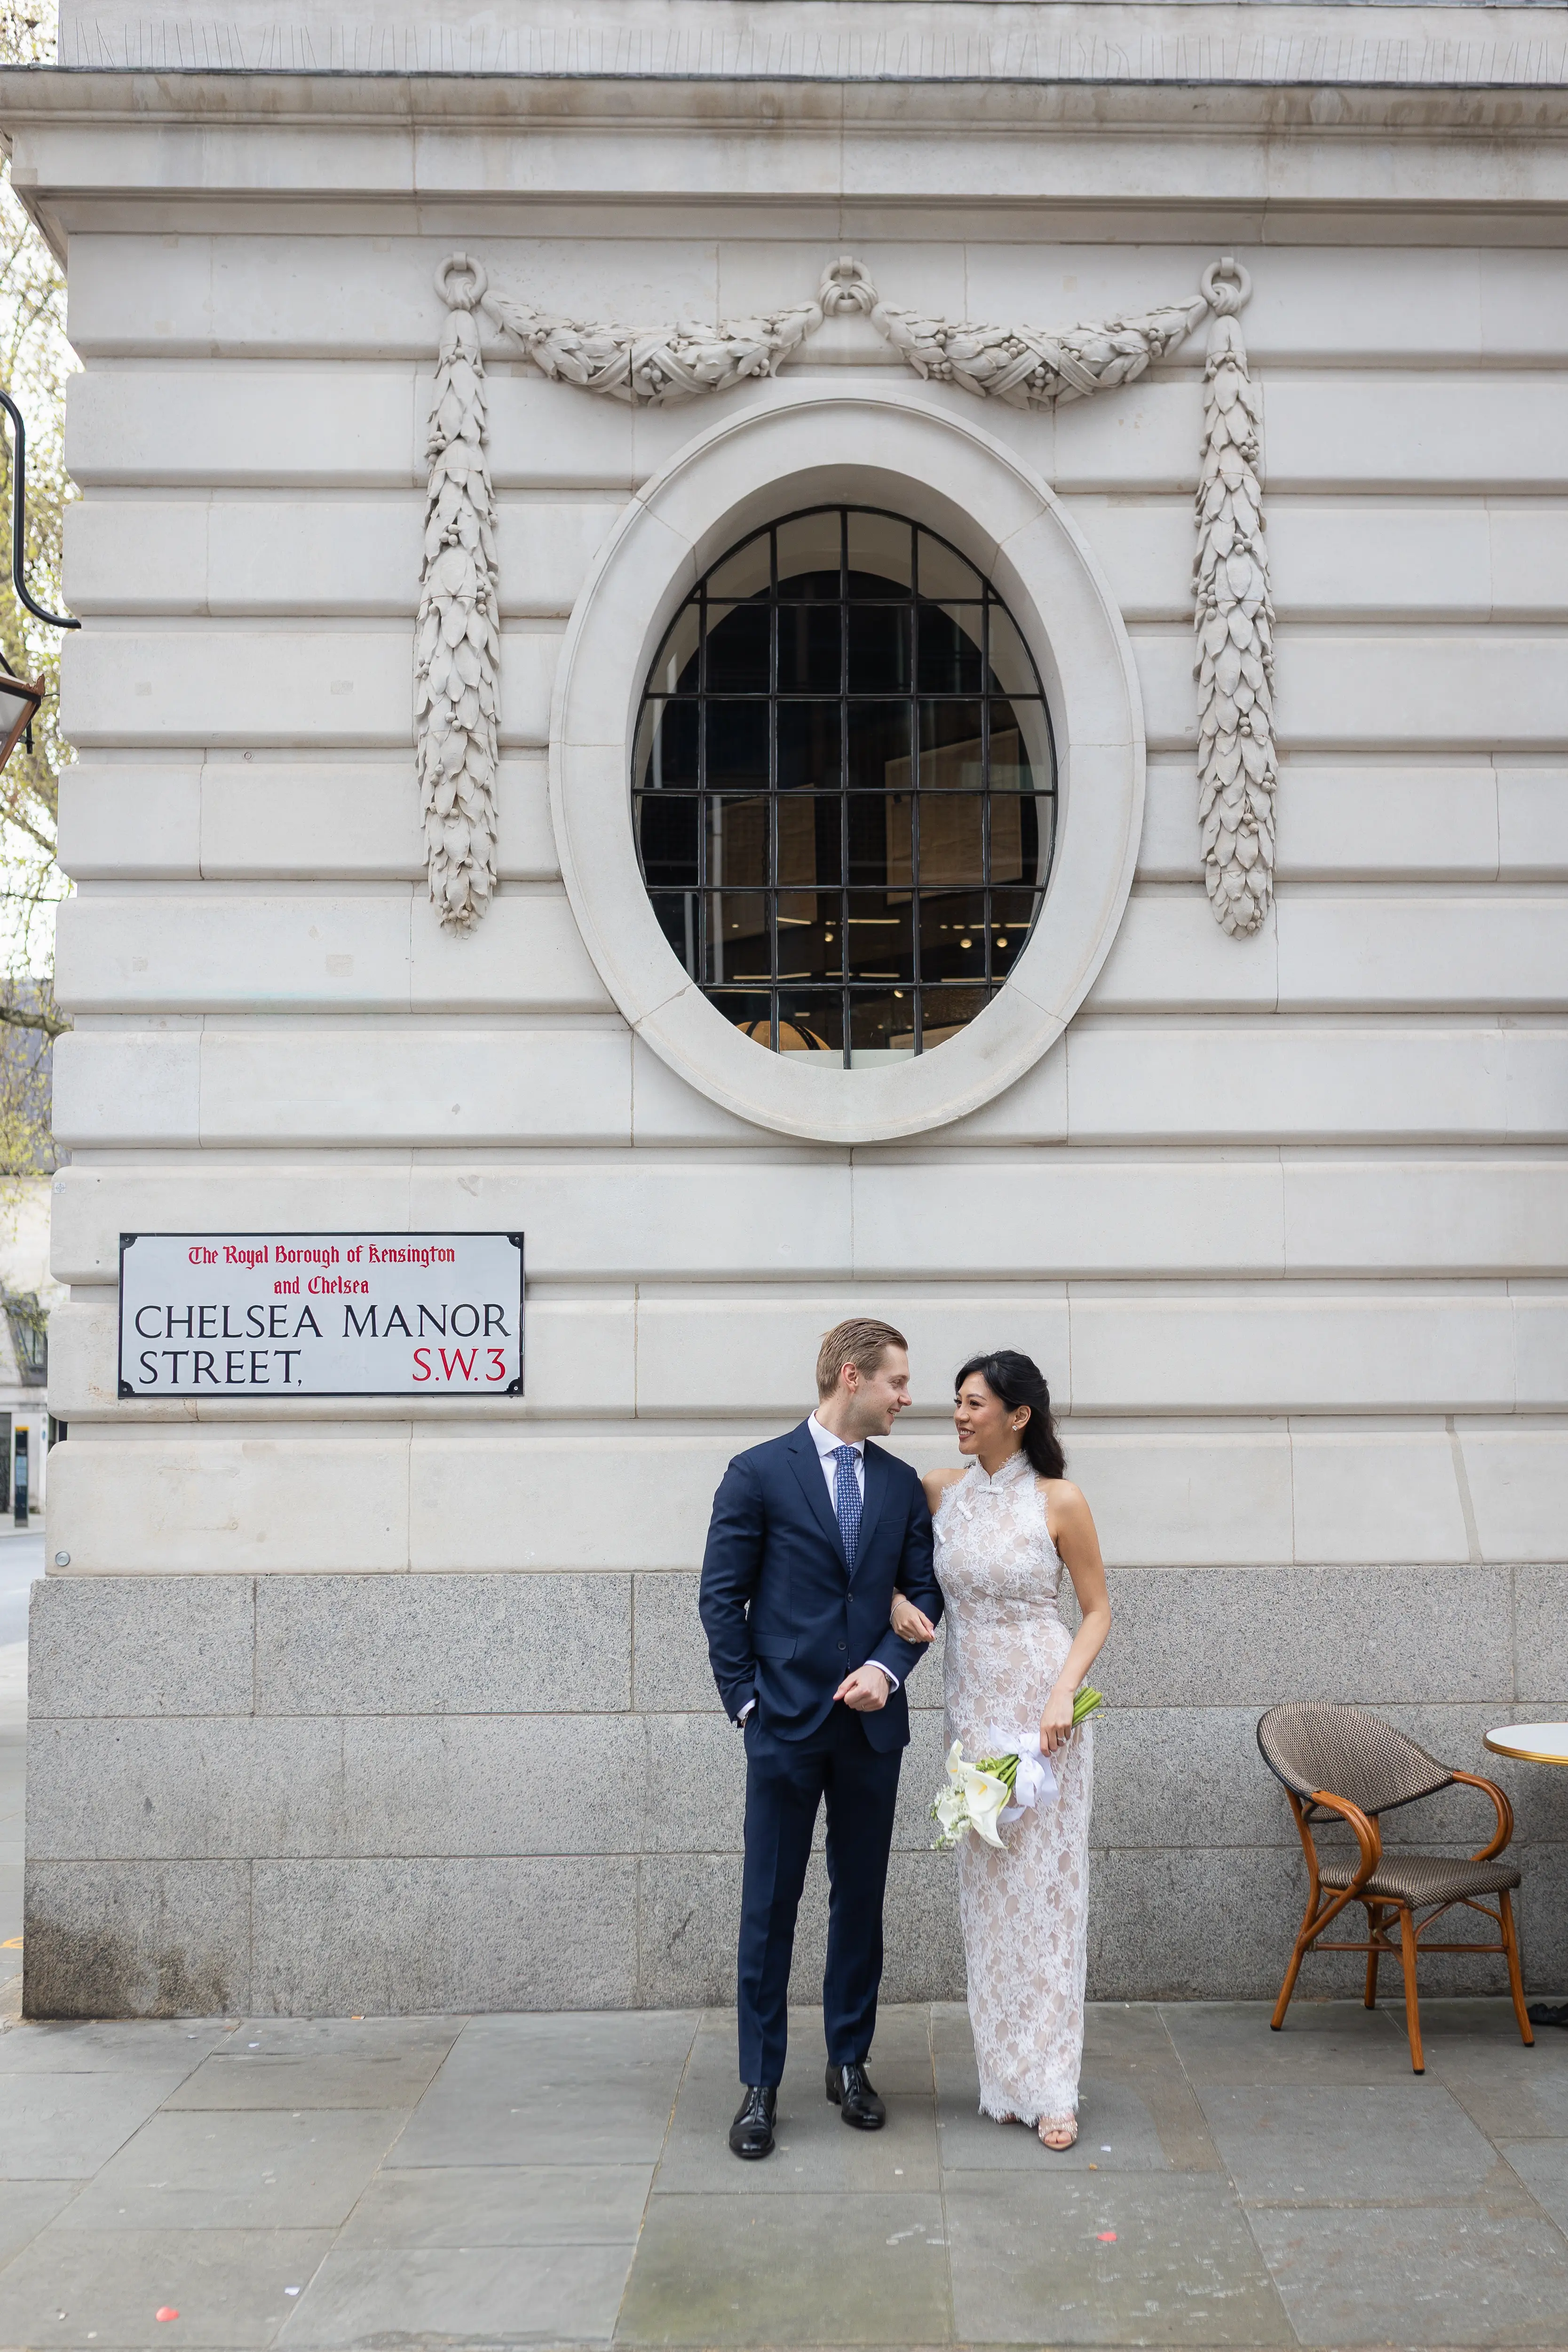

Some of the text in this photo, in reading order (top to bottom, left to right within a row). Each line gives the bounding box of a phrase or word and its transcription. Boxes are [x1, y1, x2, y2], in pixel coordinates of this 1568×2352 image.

[188, 1243, 455, 1270] The Royal Borough of Kensington
[274, 1275, 369, 1295] and Chelsea
[135, 1304, 512, 1338] CHELSEA MANOR
[139, 1347, 506, 1386] STREET, S.W.3
